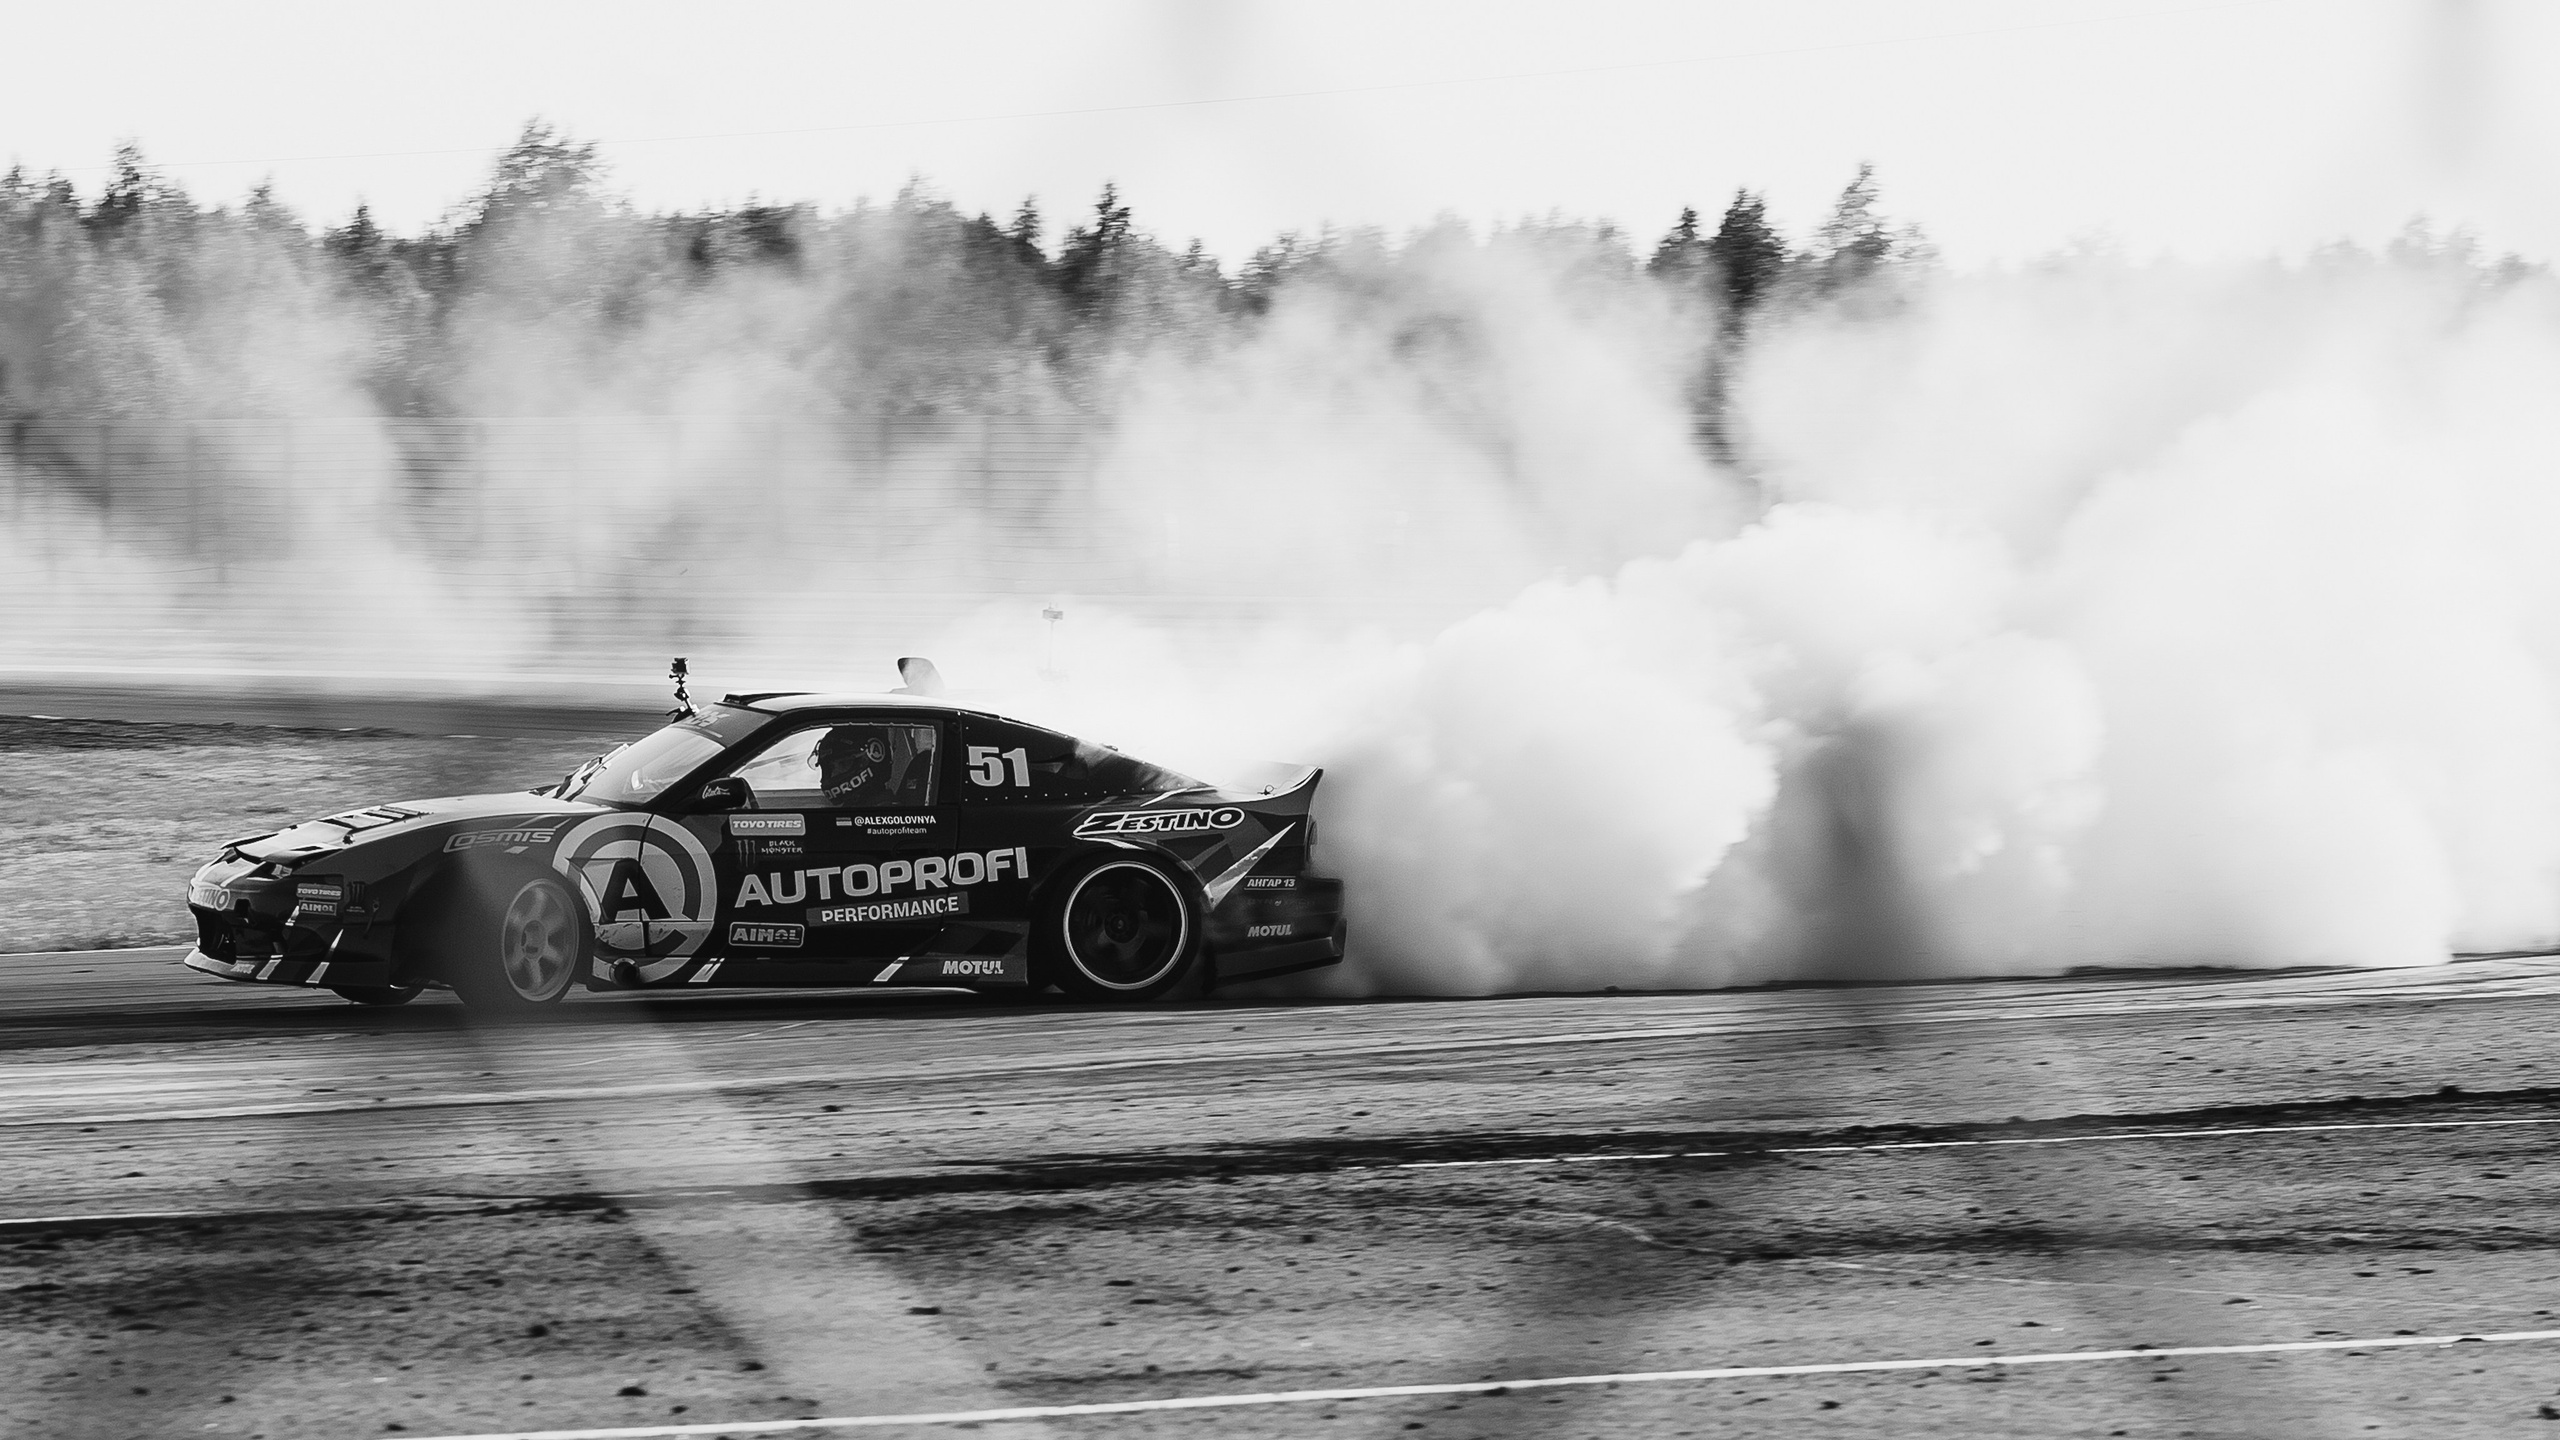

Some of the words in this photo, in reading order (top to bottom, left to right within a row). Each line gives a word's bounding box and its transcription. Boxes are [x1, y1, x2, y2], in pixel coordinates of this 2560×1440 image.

[968, 746, 1030, 786] 51
[733, 820, 765, 828] TOYO
[767, 820, 802, 828] TIRES
[854, 815, 937, 826] @ALEXGOLOVNYA
[1073, 807, 1245, 836] ZESTINO
[866, 826, 927, 836] #autoprofiteam
[761, 846, 804, 854] MONSTER
[734, 847, 1029, 908] AUTOPROFI
[1247, 879, 1282, 887] АНГАР
[1283, 879, 1295, 887] 13
[297, 888, 319, 896] TOYO
[319, 889, 342, 898] TIRES
[301, 903, 334, 912] AIMOL
[822, 897, 959, 922] PERFORMANCE
[732, 928, 800, 942] AIMOL
[1247, 924, 1293, 938] MOTUL
[942, 960, 1005, 975] MOTUL
